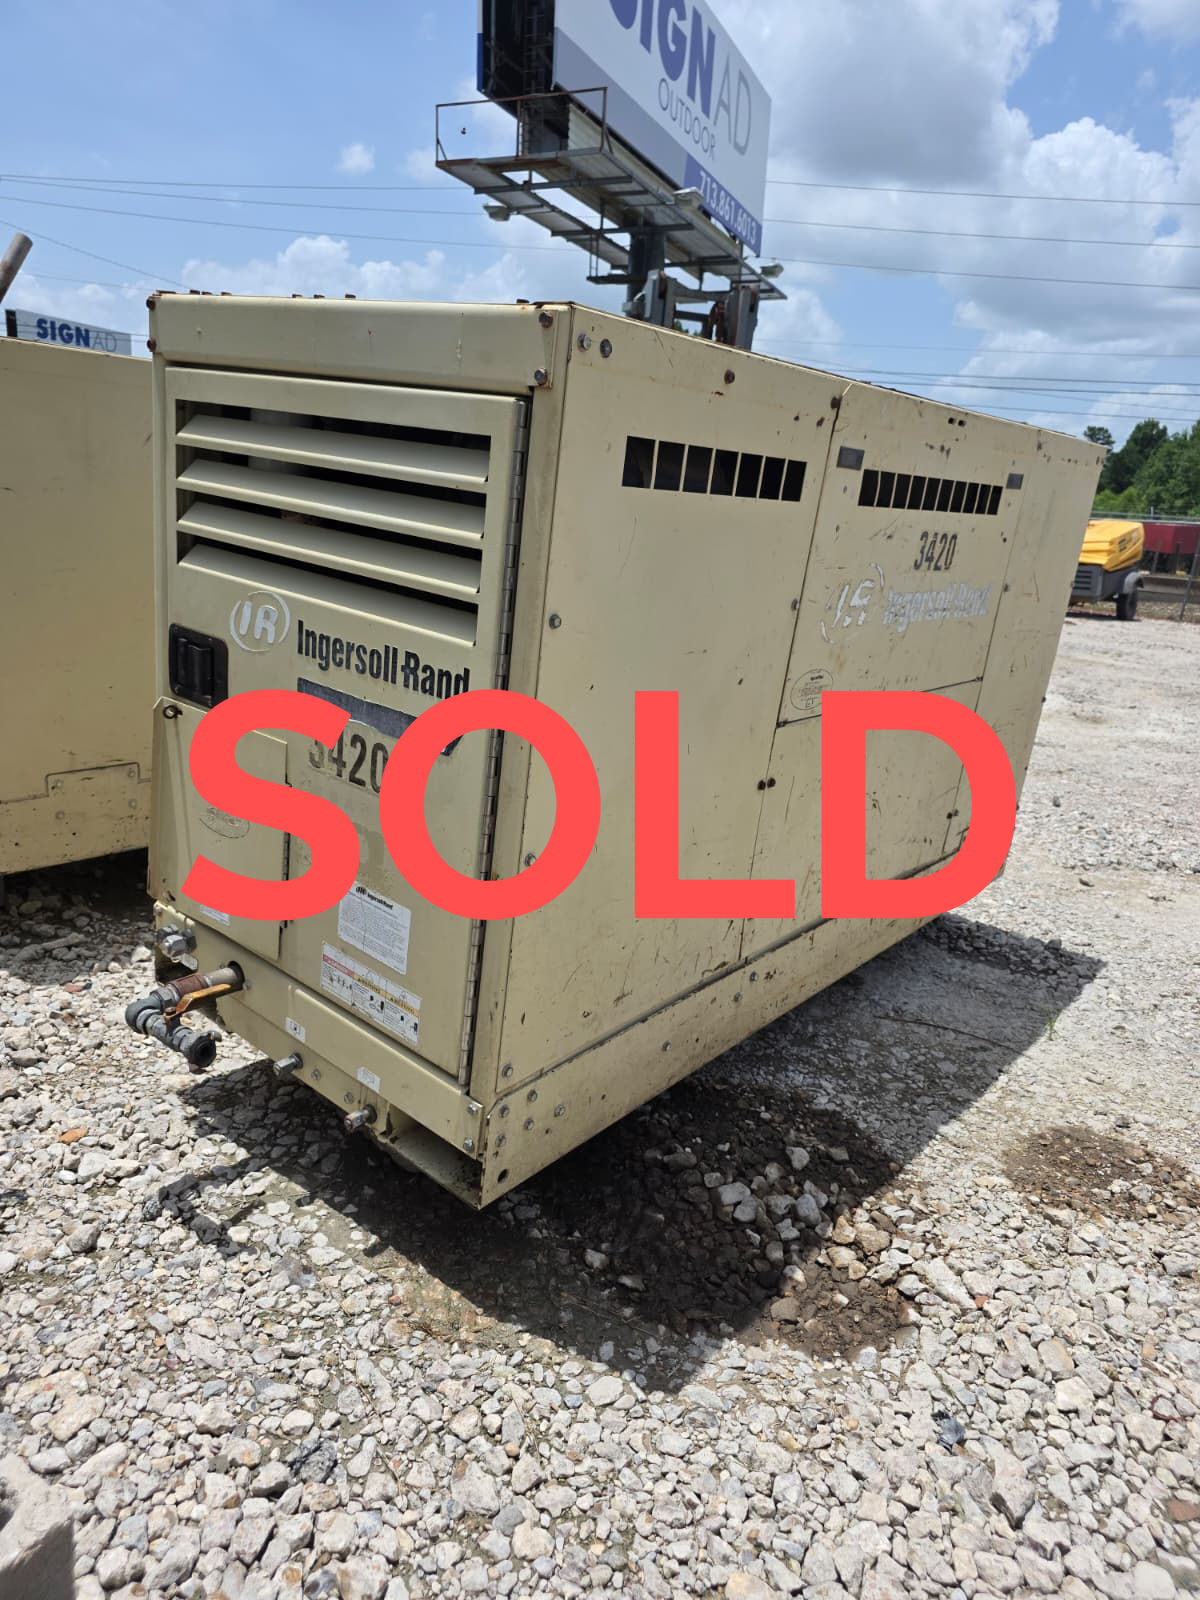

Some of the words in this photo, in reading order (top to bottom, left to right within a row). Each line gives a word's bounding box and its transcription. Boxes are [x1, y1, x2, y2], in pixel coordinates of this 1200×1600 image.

[658, 77, 716, 160] OUTDOOR
[914, 530, 958, 571] 3420
[239, 601, 279, 644] IR
